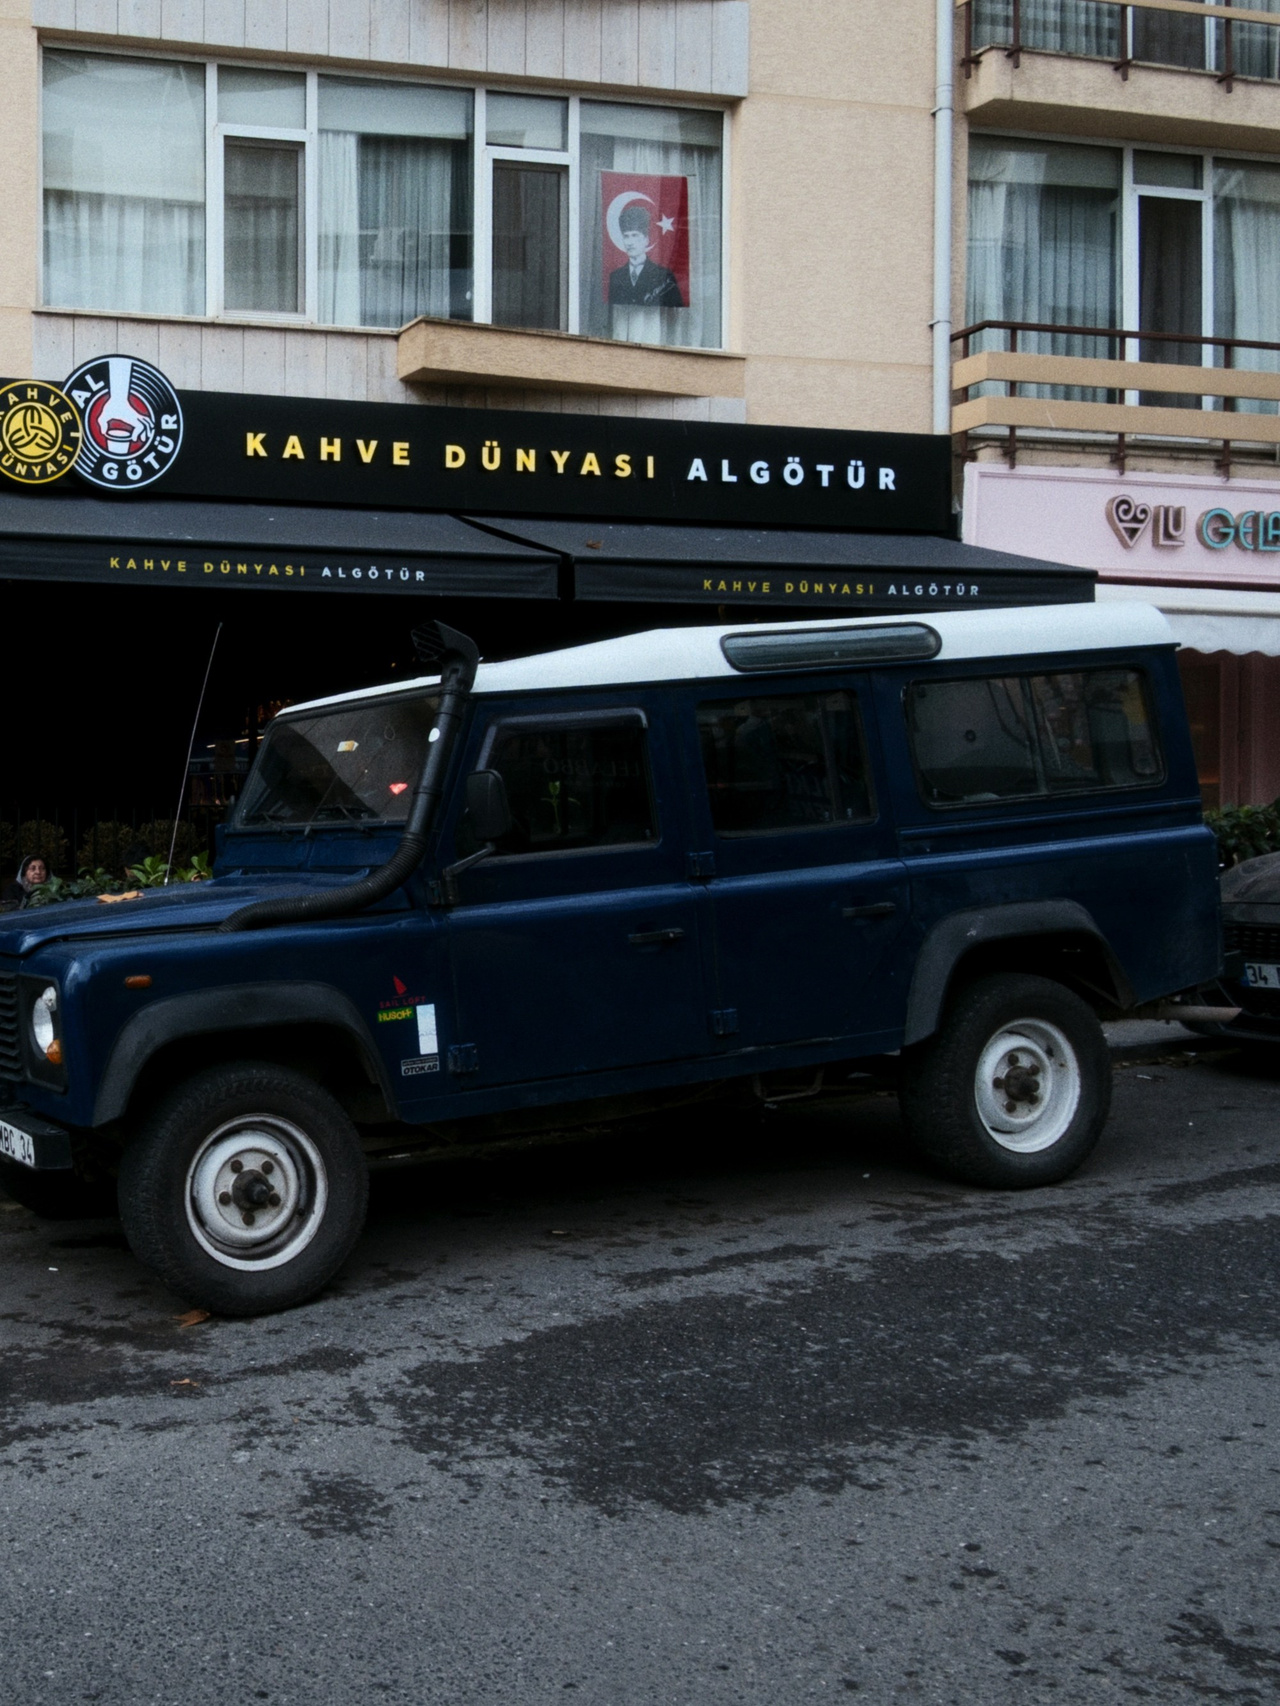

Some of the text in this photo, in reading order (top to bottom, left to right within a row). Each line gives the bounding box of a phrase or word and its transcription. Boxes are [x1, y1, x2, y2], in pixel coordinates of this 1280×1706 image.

[71, 374, 105, 409] AL
[102, 414, 178, 481] GÖTÜR
[246, 432, 897, 492] KAHVE DÜNYASI ALGÖTÜR
[109, 557, 426, 581] KAHVE DÜNYASI ALGÖTÜR
[703, 578, 980, 596] KAHVE DÜNYASI ALGÖTÜR
[1247, 965, 1268, 985] 34
[379, 1000, 400, 1009] SAIL
[403, 1063, 438, 1075] OTOKAR
[20, 1133, 33, 1164] 34
